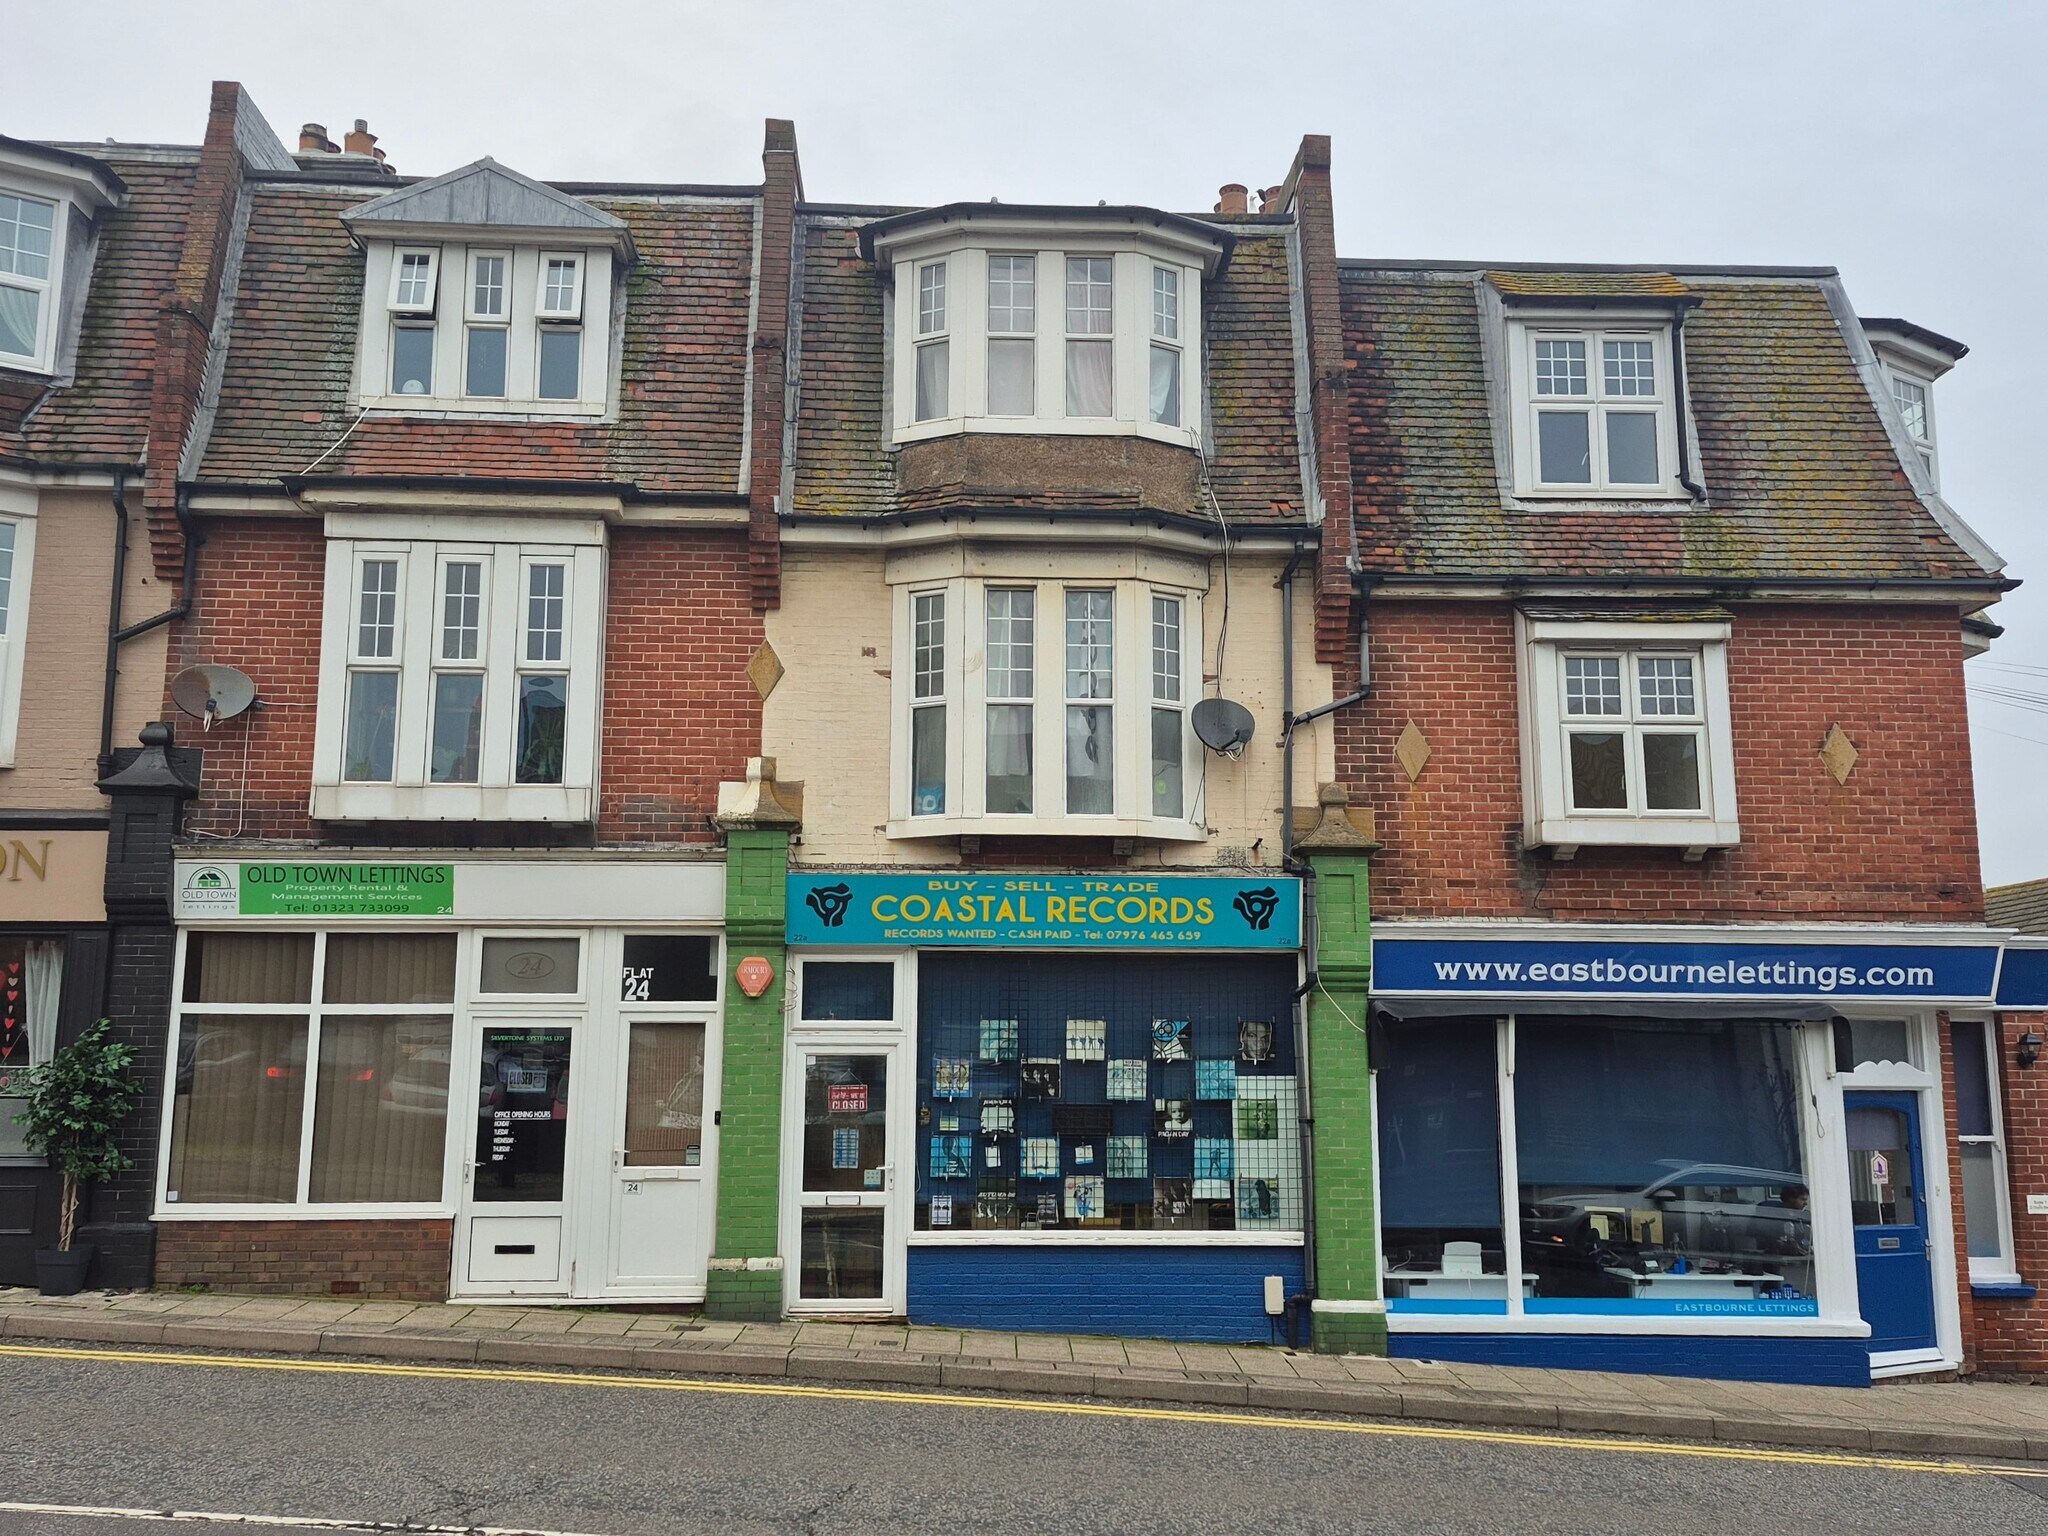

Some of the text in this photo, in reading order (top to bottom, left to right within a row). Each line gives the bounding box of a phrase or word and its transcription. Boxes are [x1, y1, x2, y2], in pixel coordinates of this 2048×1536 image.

[0, 839, 53, 882] N
[247, 866, 445, 883] OLD TOWN LETTINGS
[286, 884, 409, 893] Property Rental &
[928, 881, 979, 891] BUY
[1004, 882, 1057, 892] SELL
[1082, 882, 1159, 893] TRADE
[182, 890, 237, 899] OLD TOWN
[271, 893, 364, 901] Management
[285, 904, 409, 913] Tel: 01323 733099
[437, 906, 452, 914] 24
[871, 894, 1215, 924] COASTAL RECORDS
[794, 934, 808, 942] 22a
[885, 929, 943, 939] RECORDS
[947, 929, 996, 939] WANTED
[1008, 930, 1042, 939] CASH
[1045, 930, 1072, 939] PAID
[1084, 930, 1102, 940] Tel:
[1106, 930, 1146, 940] 07976
[1151, 930, 1174, 940] 465
[1177, 931, 1201, 940] 659
[1277, 937, 1292, 945] 22a
[518, 957, 543, 975] 24
[623, 967, 654, 979] FLAT
[1434, 958, 1934, 991] www.eastbournelettings.com
[624, 977, 650, 1000] 24
[509, 1071, 533, 1085] CLOSED
[832, 1100, 865, 1110] CLOSED
[1675, 1303, 1815, 1312] EASTBOURNE LETTINGS
